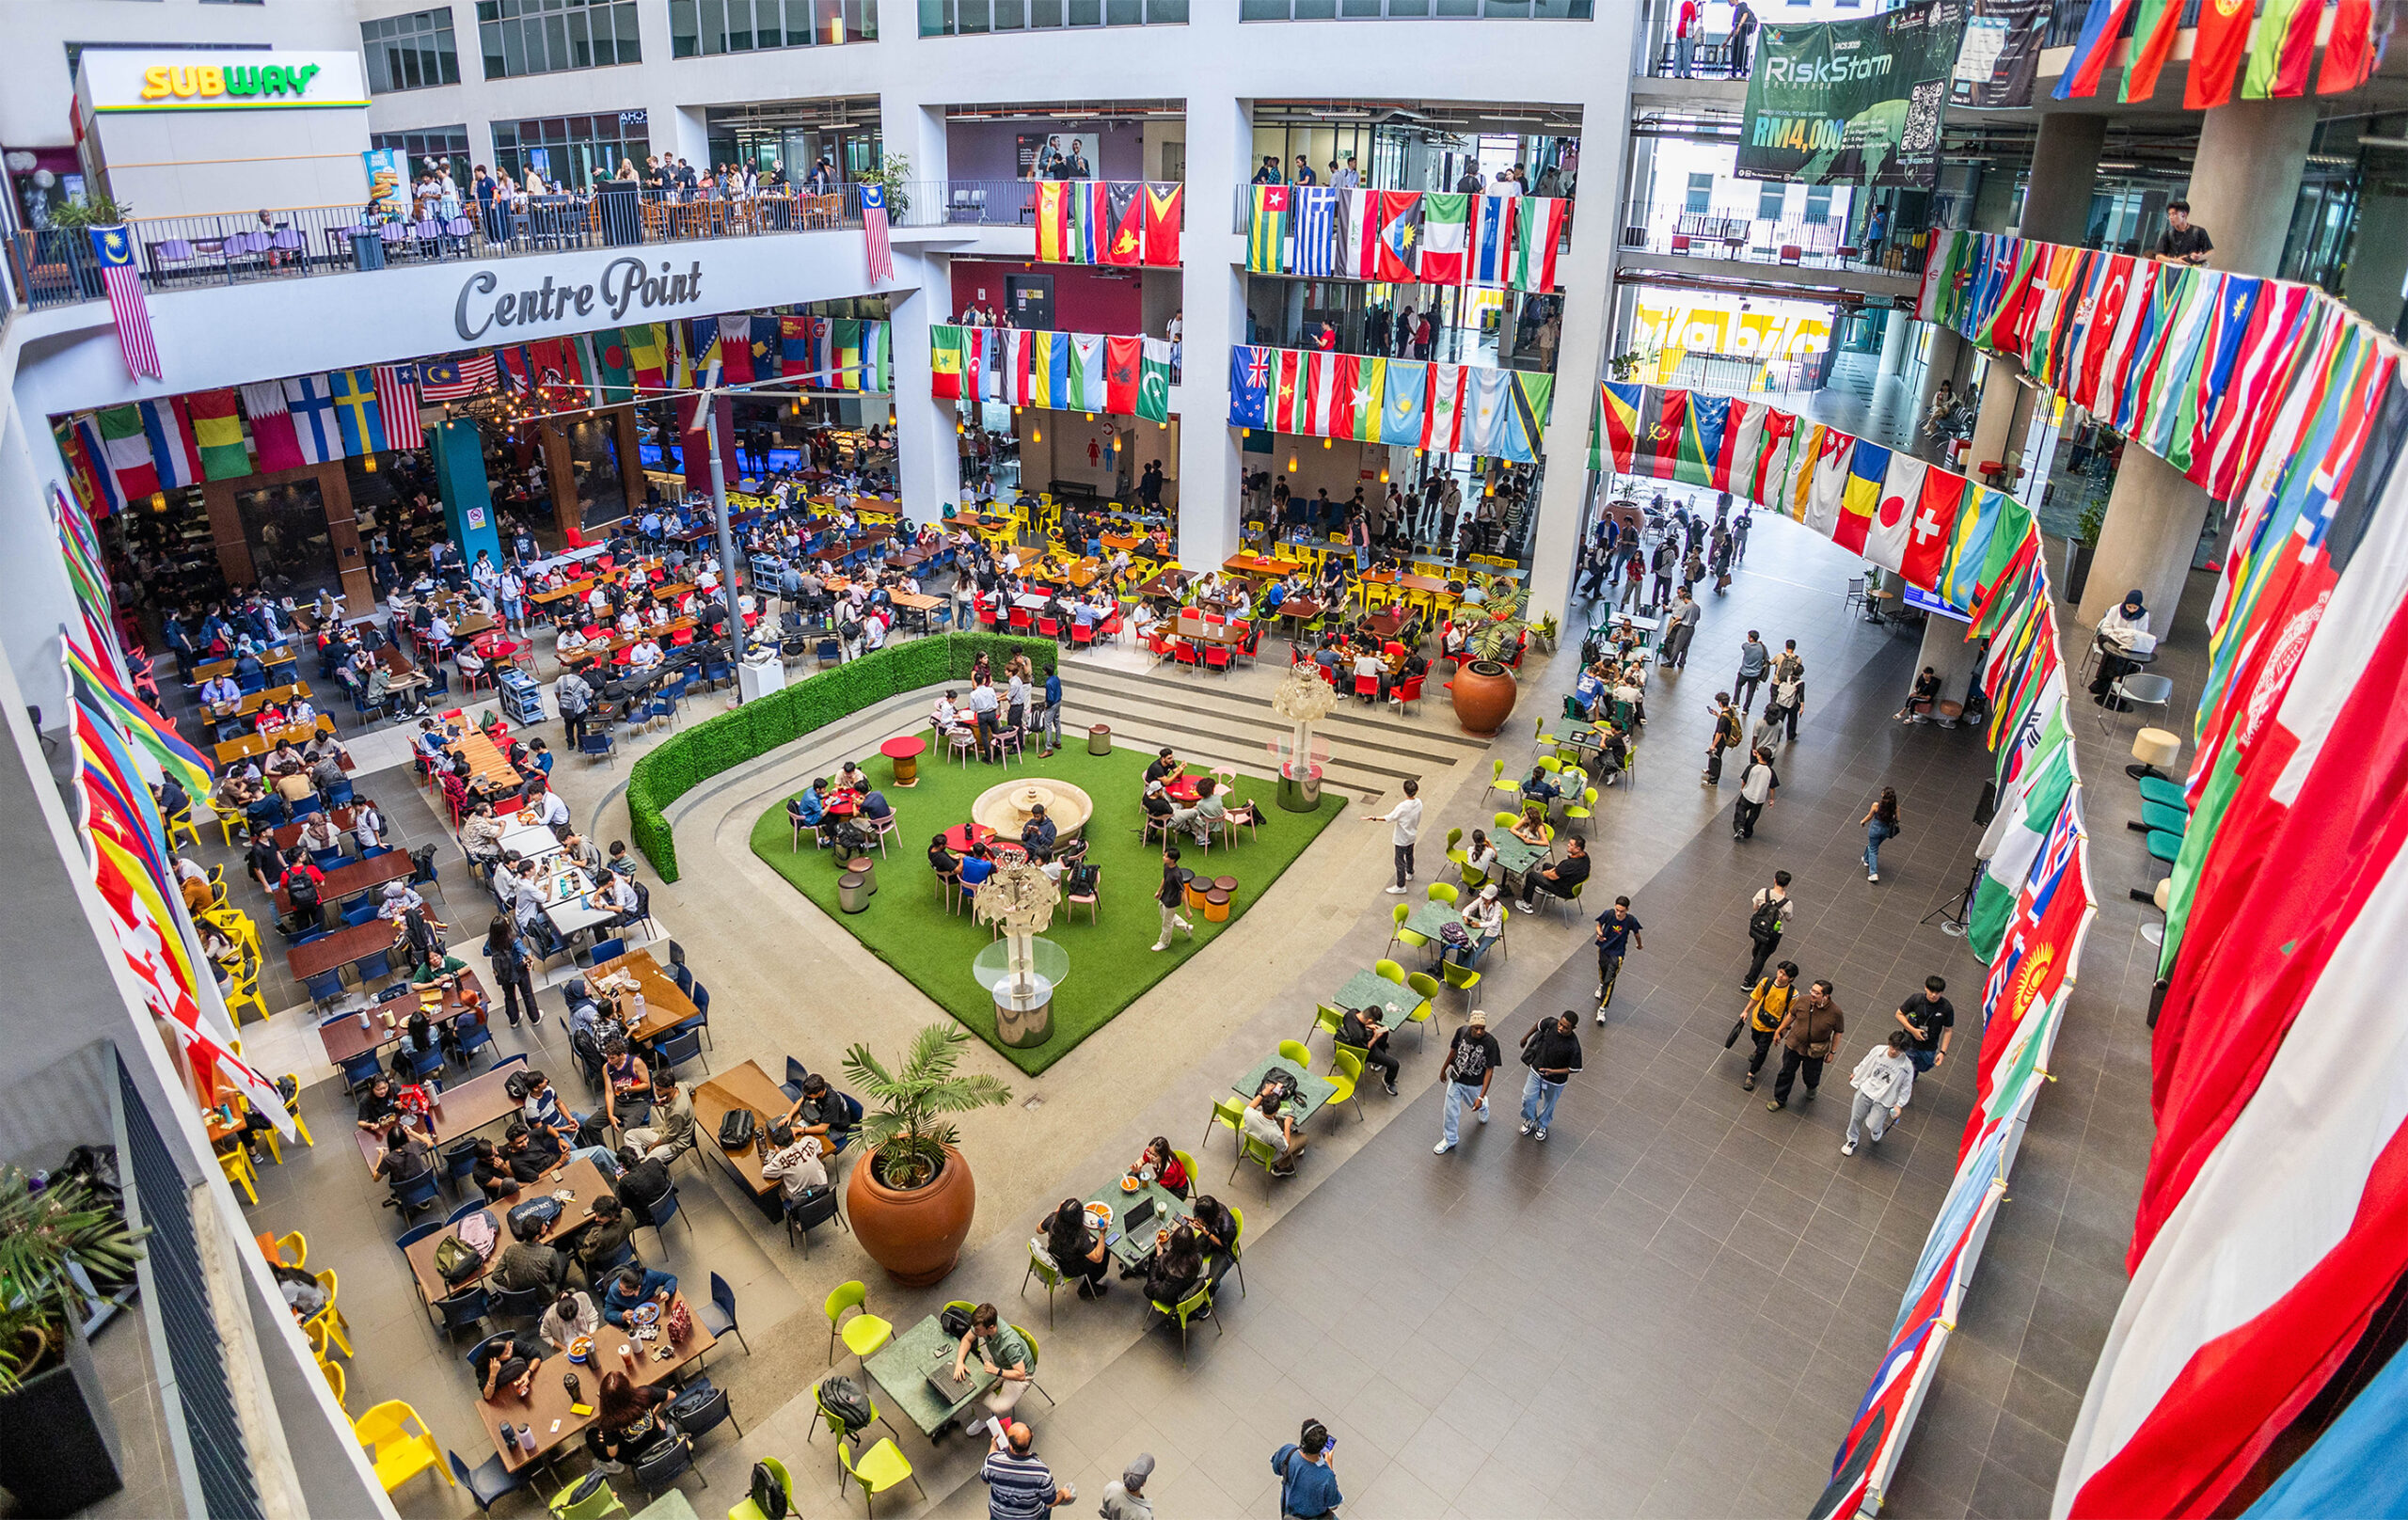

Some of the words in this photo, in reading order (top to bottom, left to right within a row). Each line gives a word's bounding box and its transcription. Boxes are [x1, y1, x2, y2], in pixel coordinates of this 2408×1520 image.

[141, 63, 321, 100] SUBWAY
[1765, 54, 1893, 83] RiskStorm
[1751, 117, 1844, 153] RM4,000
[455, 270, 594, 341] Centre
[600, 257, 703, 321] Point
